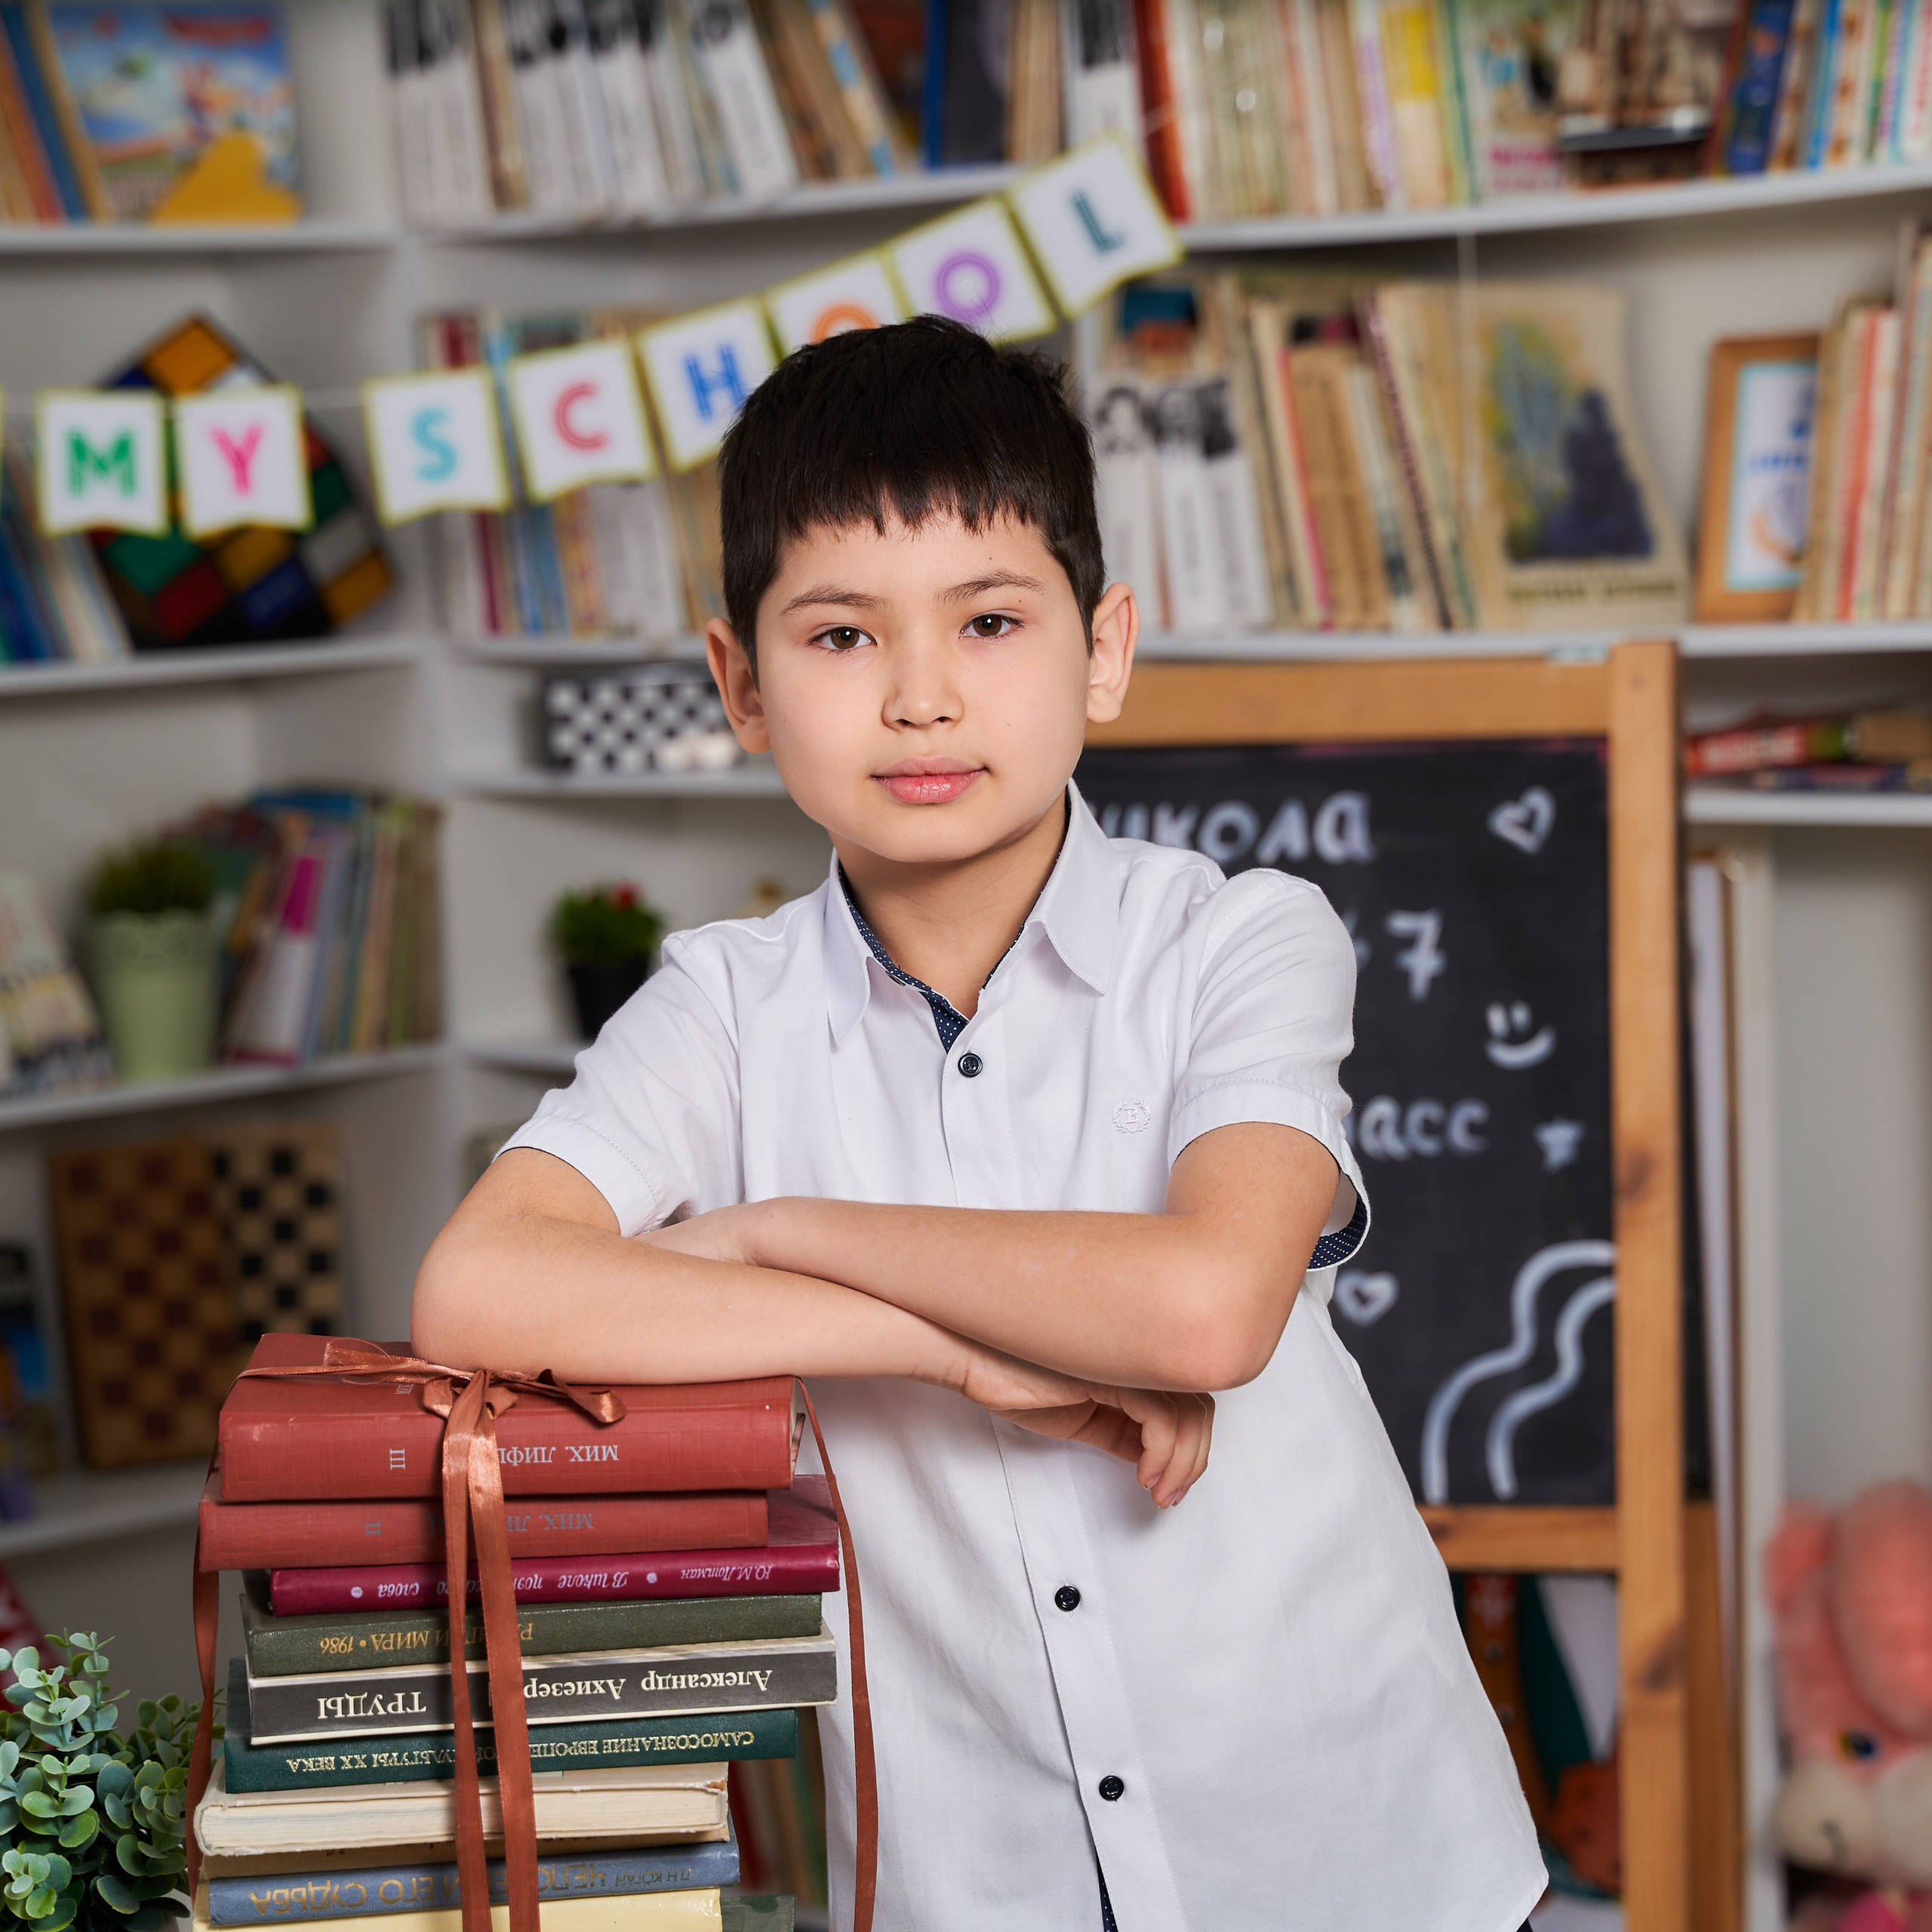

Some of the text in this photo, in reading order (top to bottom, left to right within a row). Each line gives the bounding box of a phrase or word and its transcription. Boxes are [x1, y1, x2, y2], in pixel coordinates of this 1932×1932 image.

[68, 425, 262, 498] MY
[1346, 1096, 1491, 1162] асс
[565, 1445, 619, 1463] МИХ.
[540, 1513, 594, 1531] МИХ.
[377, 1583, 420, 1598] слова
[320, 1635, 355, 1655] 1986
[370, 1629, 430, 1652] МИРА
[524, 1669, 774, 1700] Александр Ахиезер
[317, 1690, 427, 1720] ТРУДЫ
[602, 1730, 755, 1755] САМОСОЗНАНИЕ
[286, 1754, 336, 1774] ВЕКА
[615, 1867, 663, 1886] КОГАН
[249, 1878, 368, 1916] СУДЬБА
[379, 1875, 435, 1905] ЕГО
